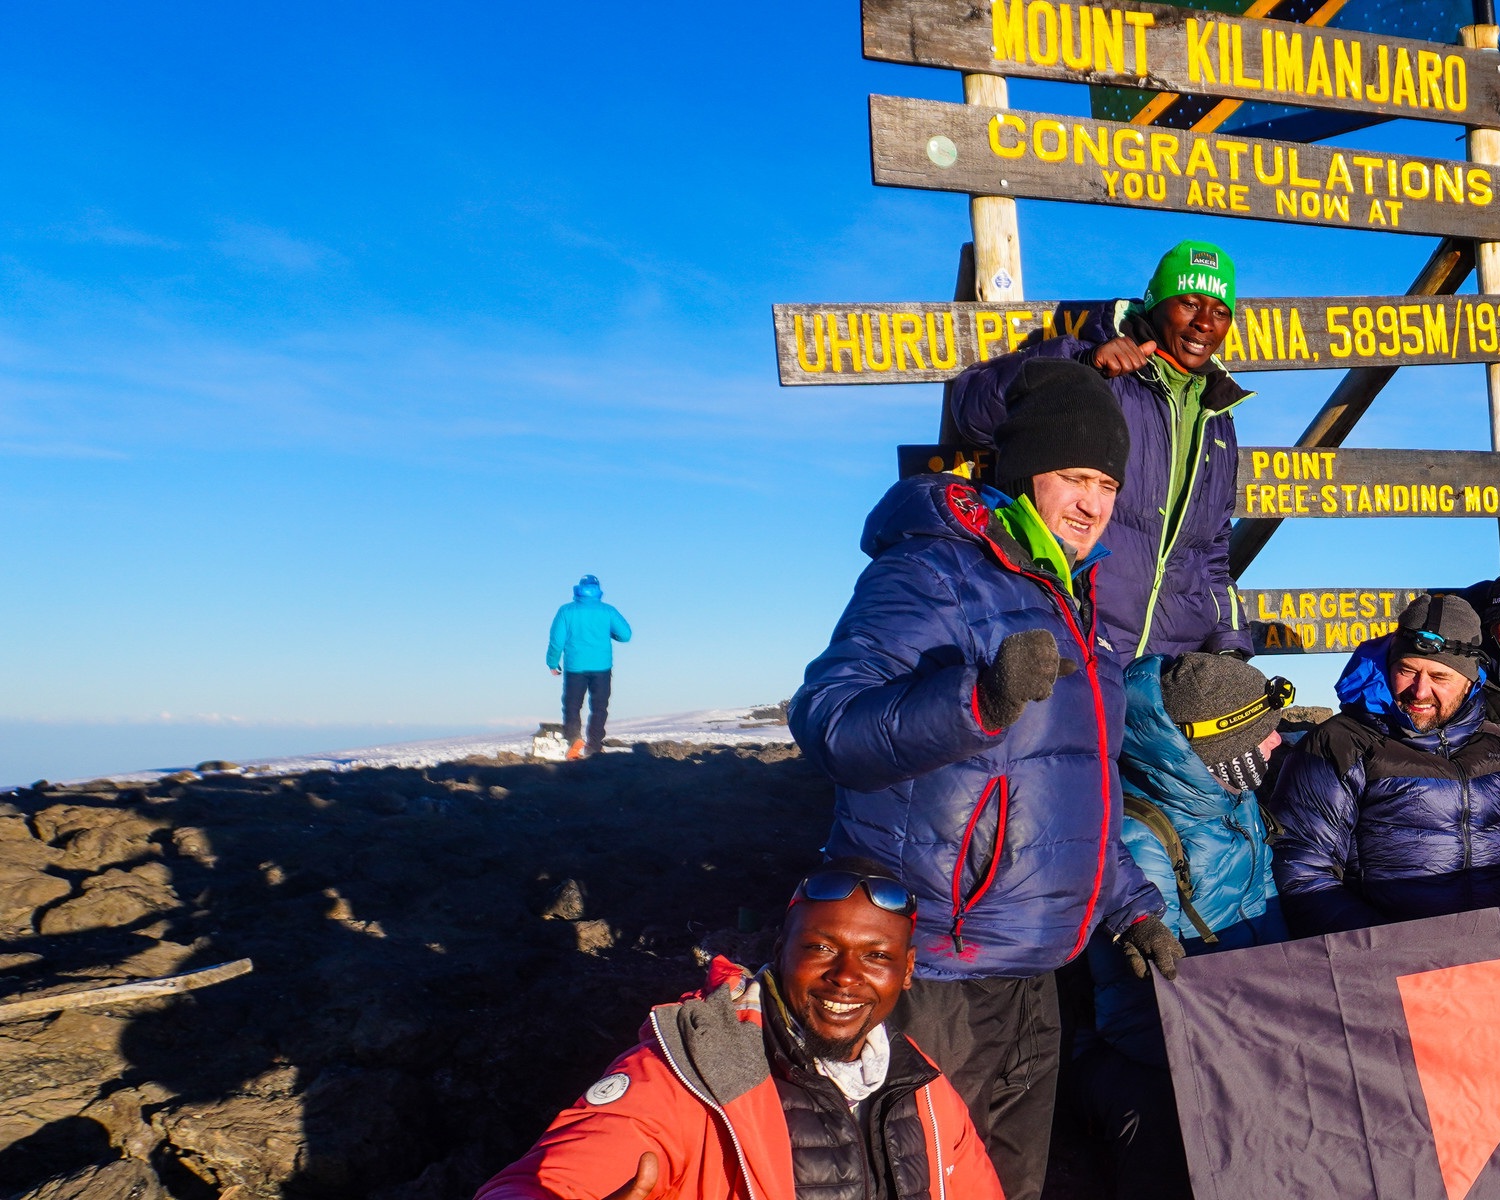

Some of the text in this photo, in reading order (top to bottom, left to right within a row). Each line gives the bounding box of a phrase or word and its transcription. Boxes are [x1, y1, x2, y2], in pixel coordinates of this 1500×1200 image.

[990, 0, 1468, 113] MOUNT KILIMANJARO
[988, 114, 1494, 207] CONGRATULATIONS
[1102, 169, 1403, 227] YOU ARE NOW AT
[1177, 273, 1229, 298] HEMING
[793, 312, 958, 373] UHURU
[1220, 307, 1320, 362] ANIA,
[1252, 451, 1337, 480] POINT
[1245, 484, 1456, 514] FREE-STANDING
[1257, 592, 1396, 619] LARGEST
[1265, 622, 1317, 648] AND
